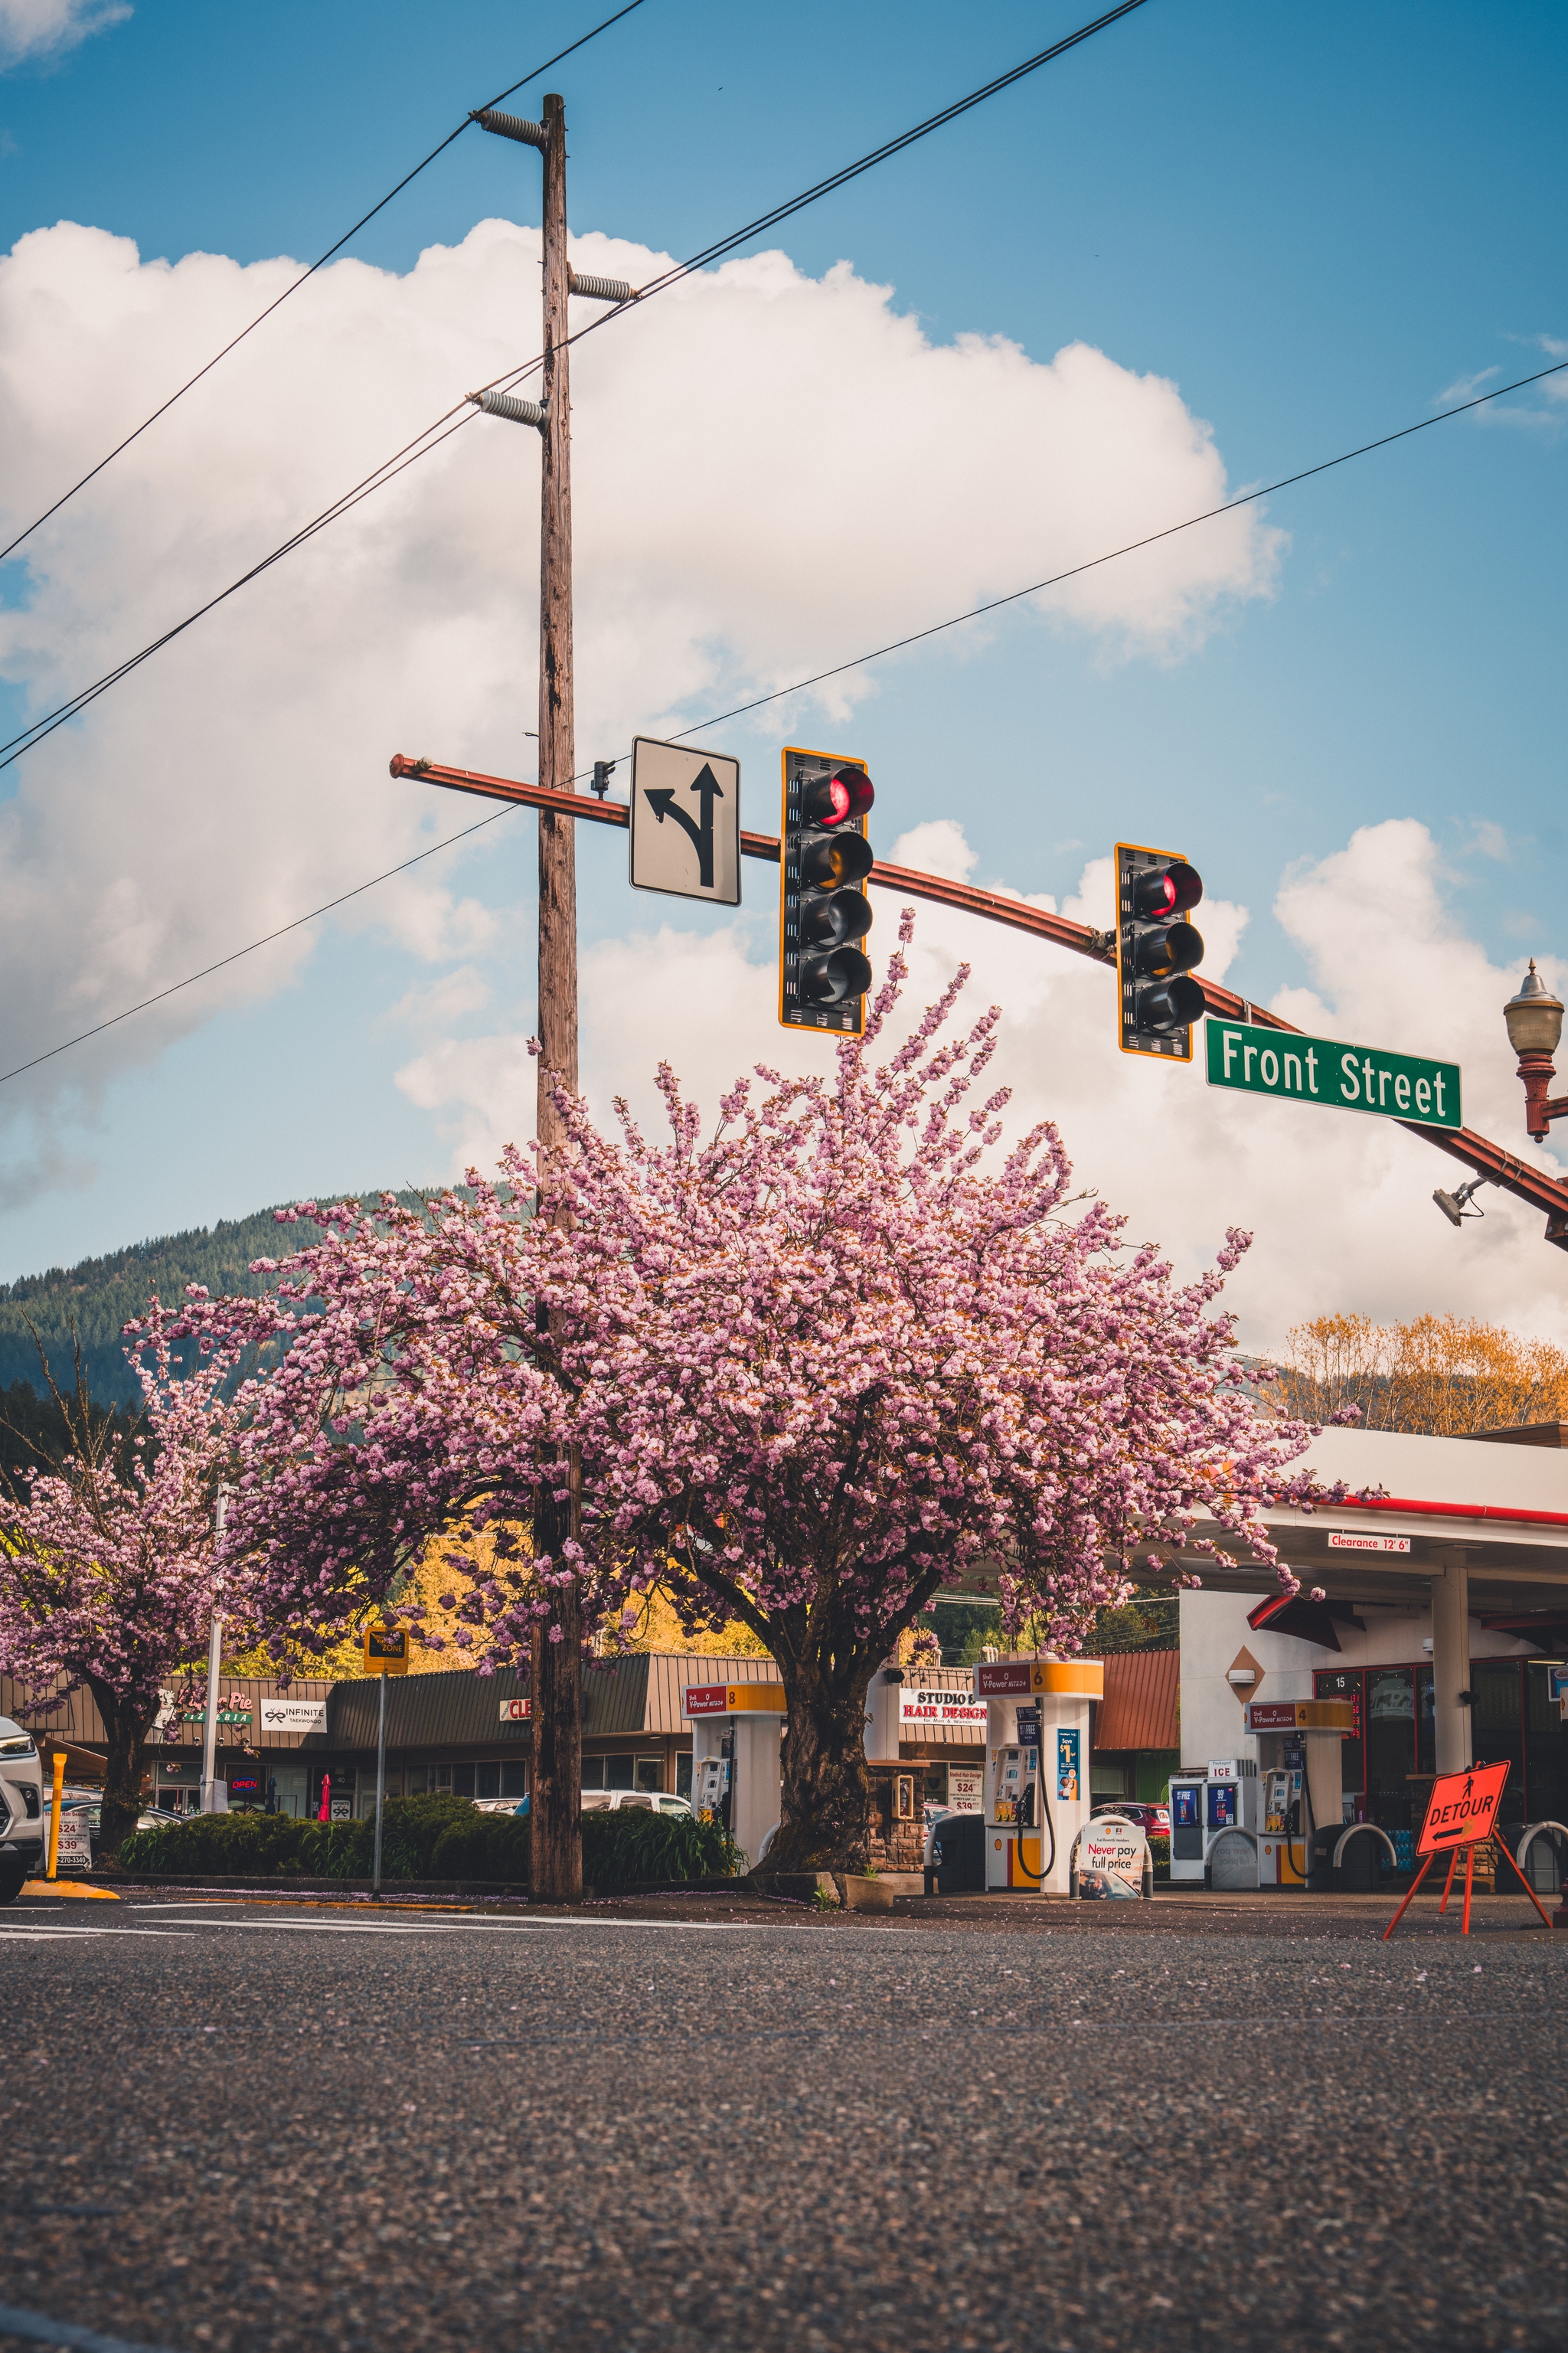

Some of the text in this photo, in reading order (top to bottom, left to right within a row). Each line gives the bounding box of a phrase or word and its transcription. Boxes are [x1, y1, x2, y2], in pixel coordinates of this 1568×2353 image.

[1223, 1029, 1446, 1117] Front Street
[1332, 1535, 1378, 1548] Clearance
[382, 1644, 402, 1652] ZONE
[983, 1680, 1007, 1688] V-Power
[1034, 1671, 1043, 1686] 6
[1336, 1677, 1345, 1688] 15
[229, 1692, 253, 1711] Pie
[728, 1691, 735, 1704] 8
[918, 1692, 967, 1704] STUDIO
[183, 1713, 247, 1722] PIZERIA
[286, 1708, 324, 1716] INFINITE
[903, 1705, 988, 1720] HAIR DESIGN
[1298, 1709, 1307, 1721] 4
[1026, 1724, 1036, 1735] FREE
[1290, 1753, 1299, 1761] FREE
[1214, 1768, 1230, 1777] ICE
[232, 1780, 258, 1789] OPEN
[957, 1783, 973, 1793] $24
[1182, 1791, 1191, 1800] FREE
[1429, 1795, 1494, 1827] DETOUR
[59, 1824, 76, 1833] $24
[58, 1841, 77, 1850] $39
[1088, 1843, 1137, 1859] Never pay
[1092, 1856, 1131, 1872] full price
